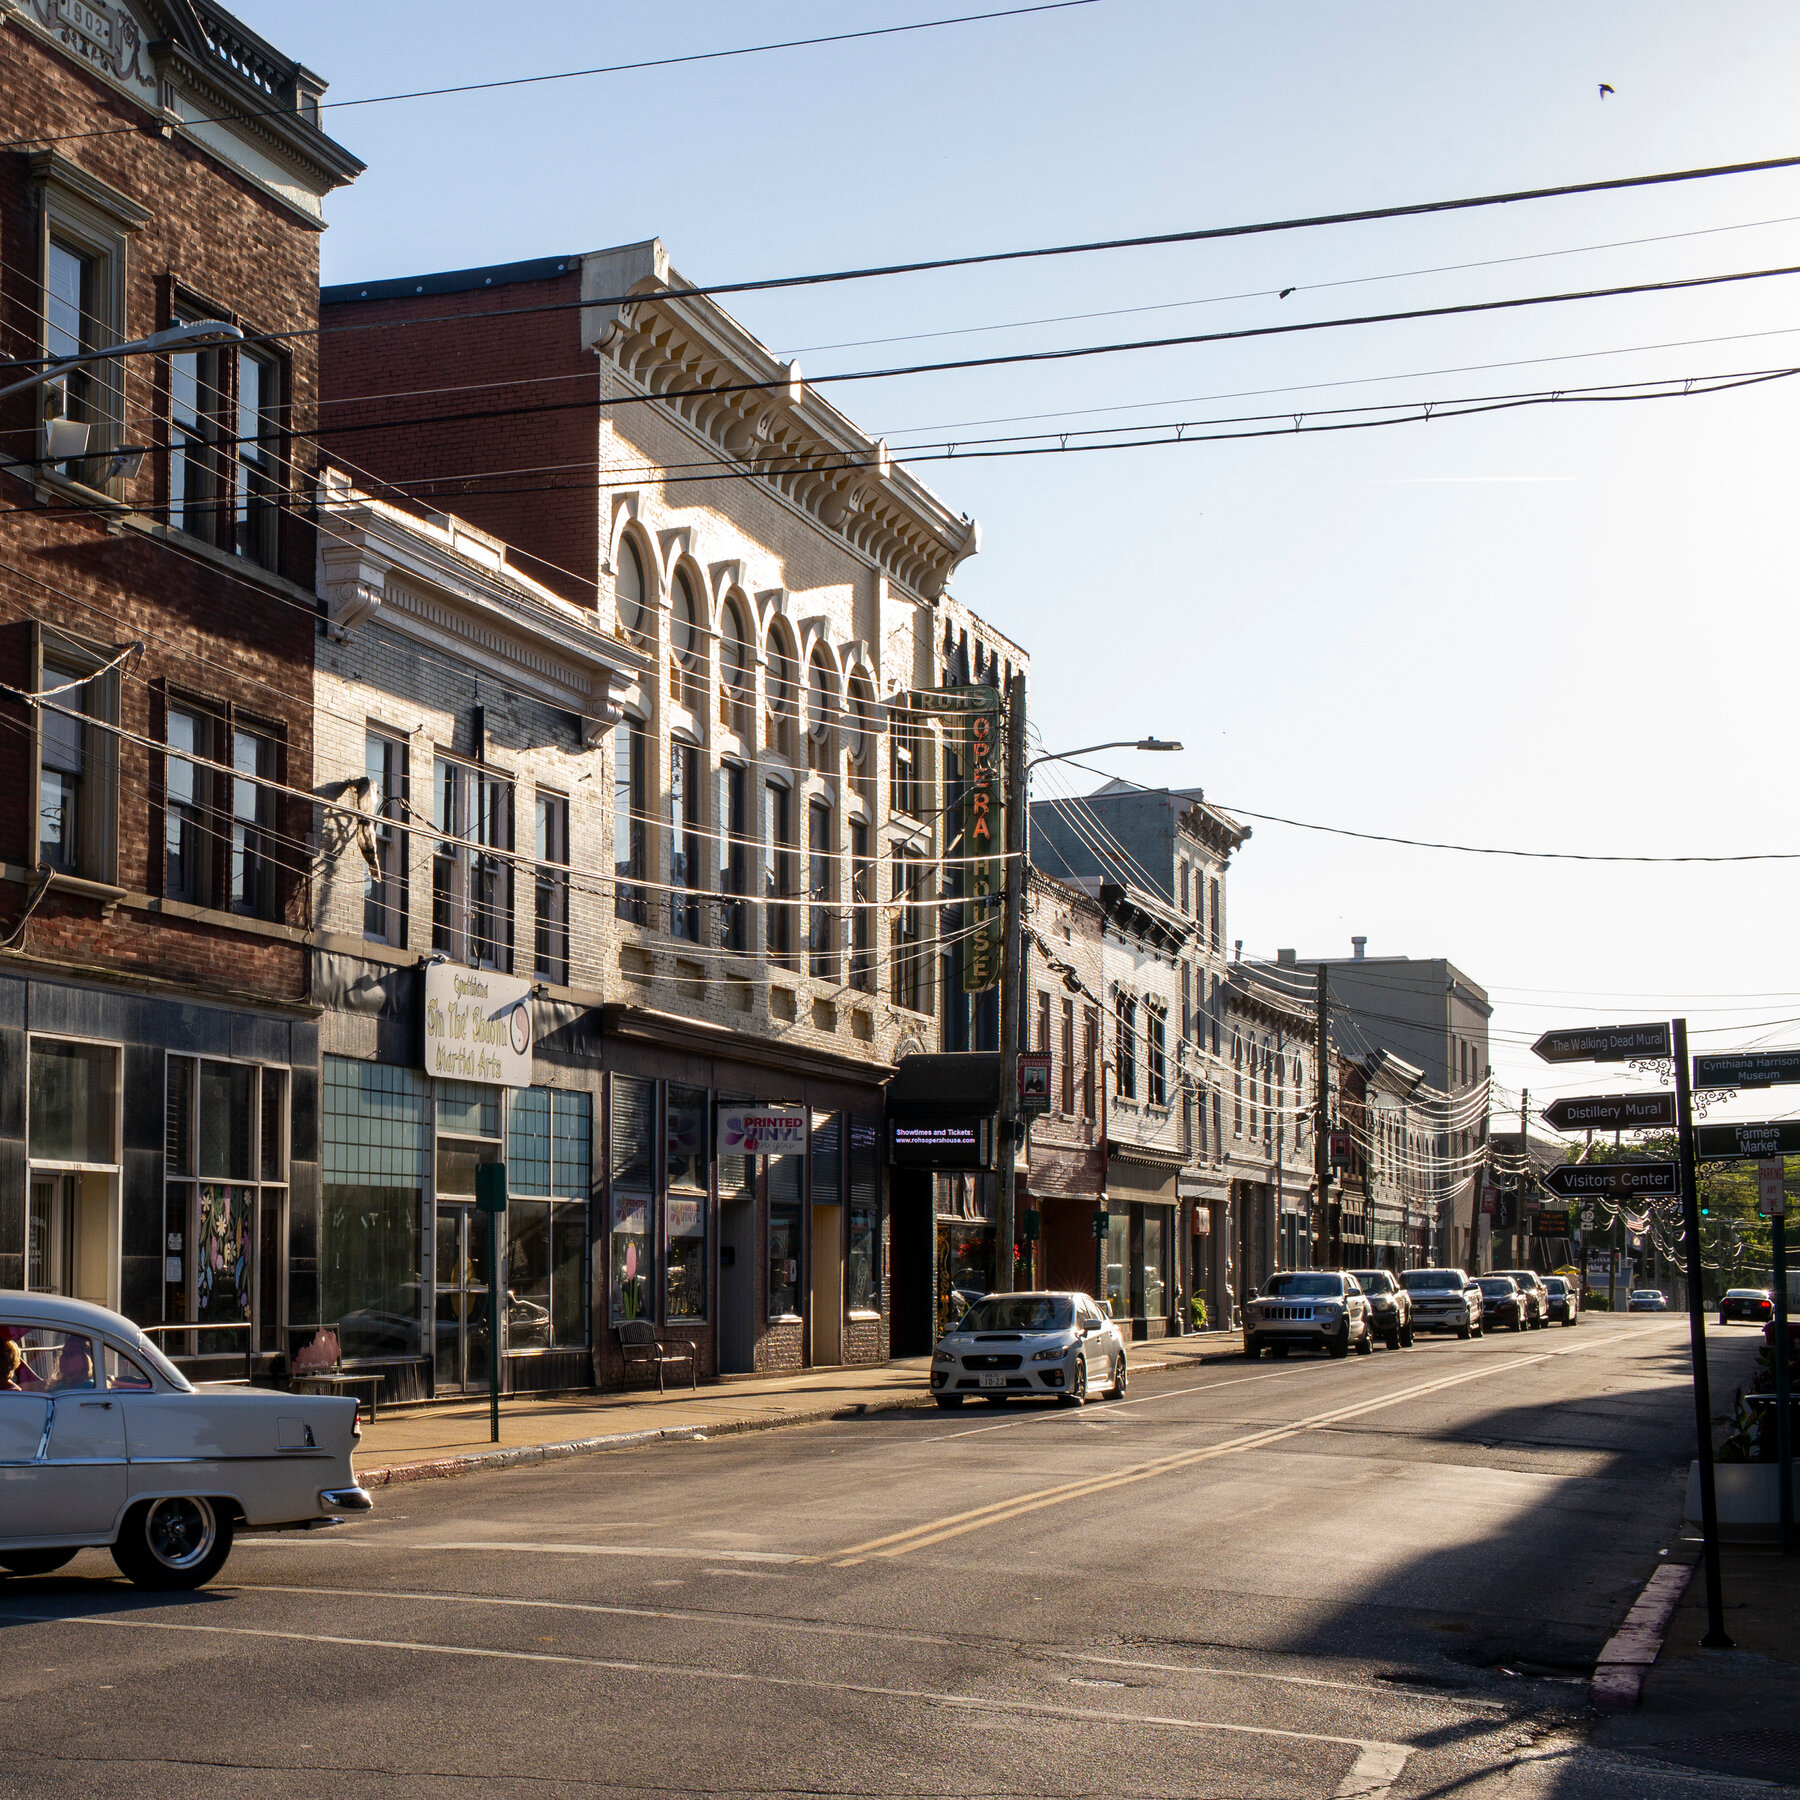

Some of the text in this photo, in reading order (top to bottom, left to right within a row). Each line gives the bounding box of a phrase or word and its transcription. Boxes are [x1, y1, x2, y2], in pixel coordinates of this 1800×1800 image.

[66, 0, 102, 38] 1902
[972, 717, 991, 976] OPERA HOUSE
[427, 998, 445, 1037] Sin
[1552, 1032, 1663, 1051] The Walking Dead Mural
[436, 1041, 501, 1079] Martial Arts
[1703, 1057, 1799, 1071] Cynthiana Harrison
[1738, 1071, 1780, 1080] Museum
[1567, 1102, 1661, 1119] Distillery Mural
[744, 1117, 803, 1128] PRINTED
[745, 1127, 803, 1141] VINYL
[1735, 1128, 1780, 1140] Farmers
[1741, 1140, 1778, 1152] Market
[1564, 1172, 1670, 1187] Visitors Center
[1583, 1212, 1592, 1220] 32
